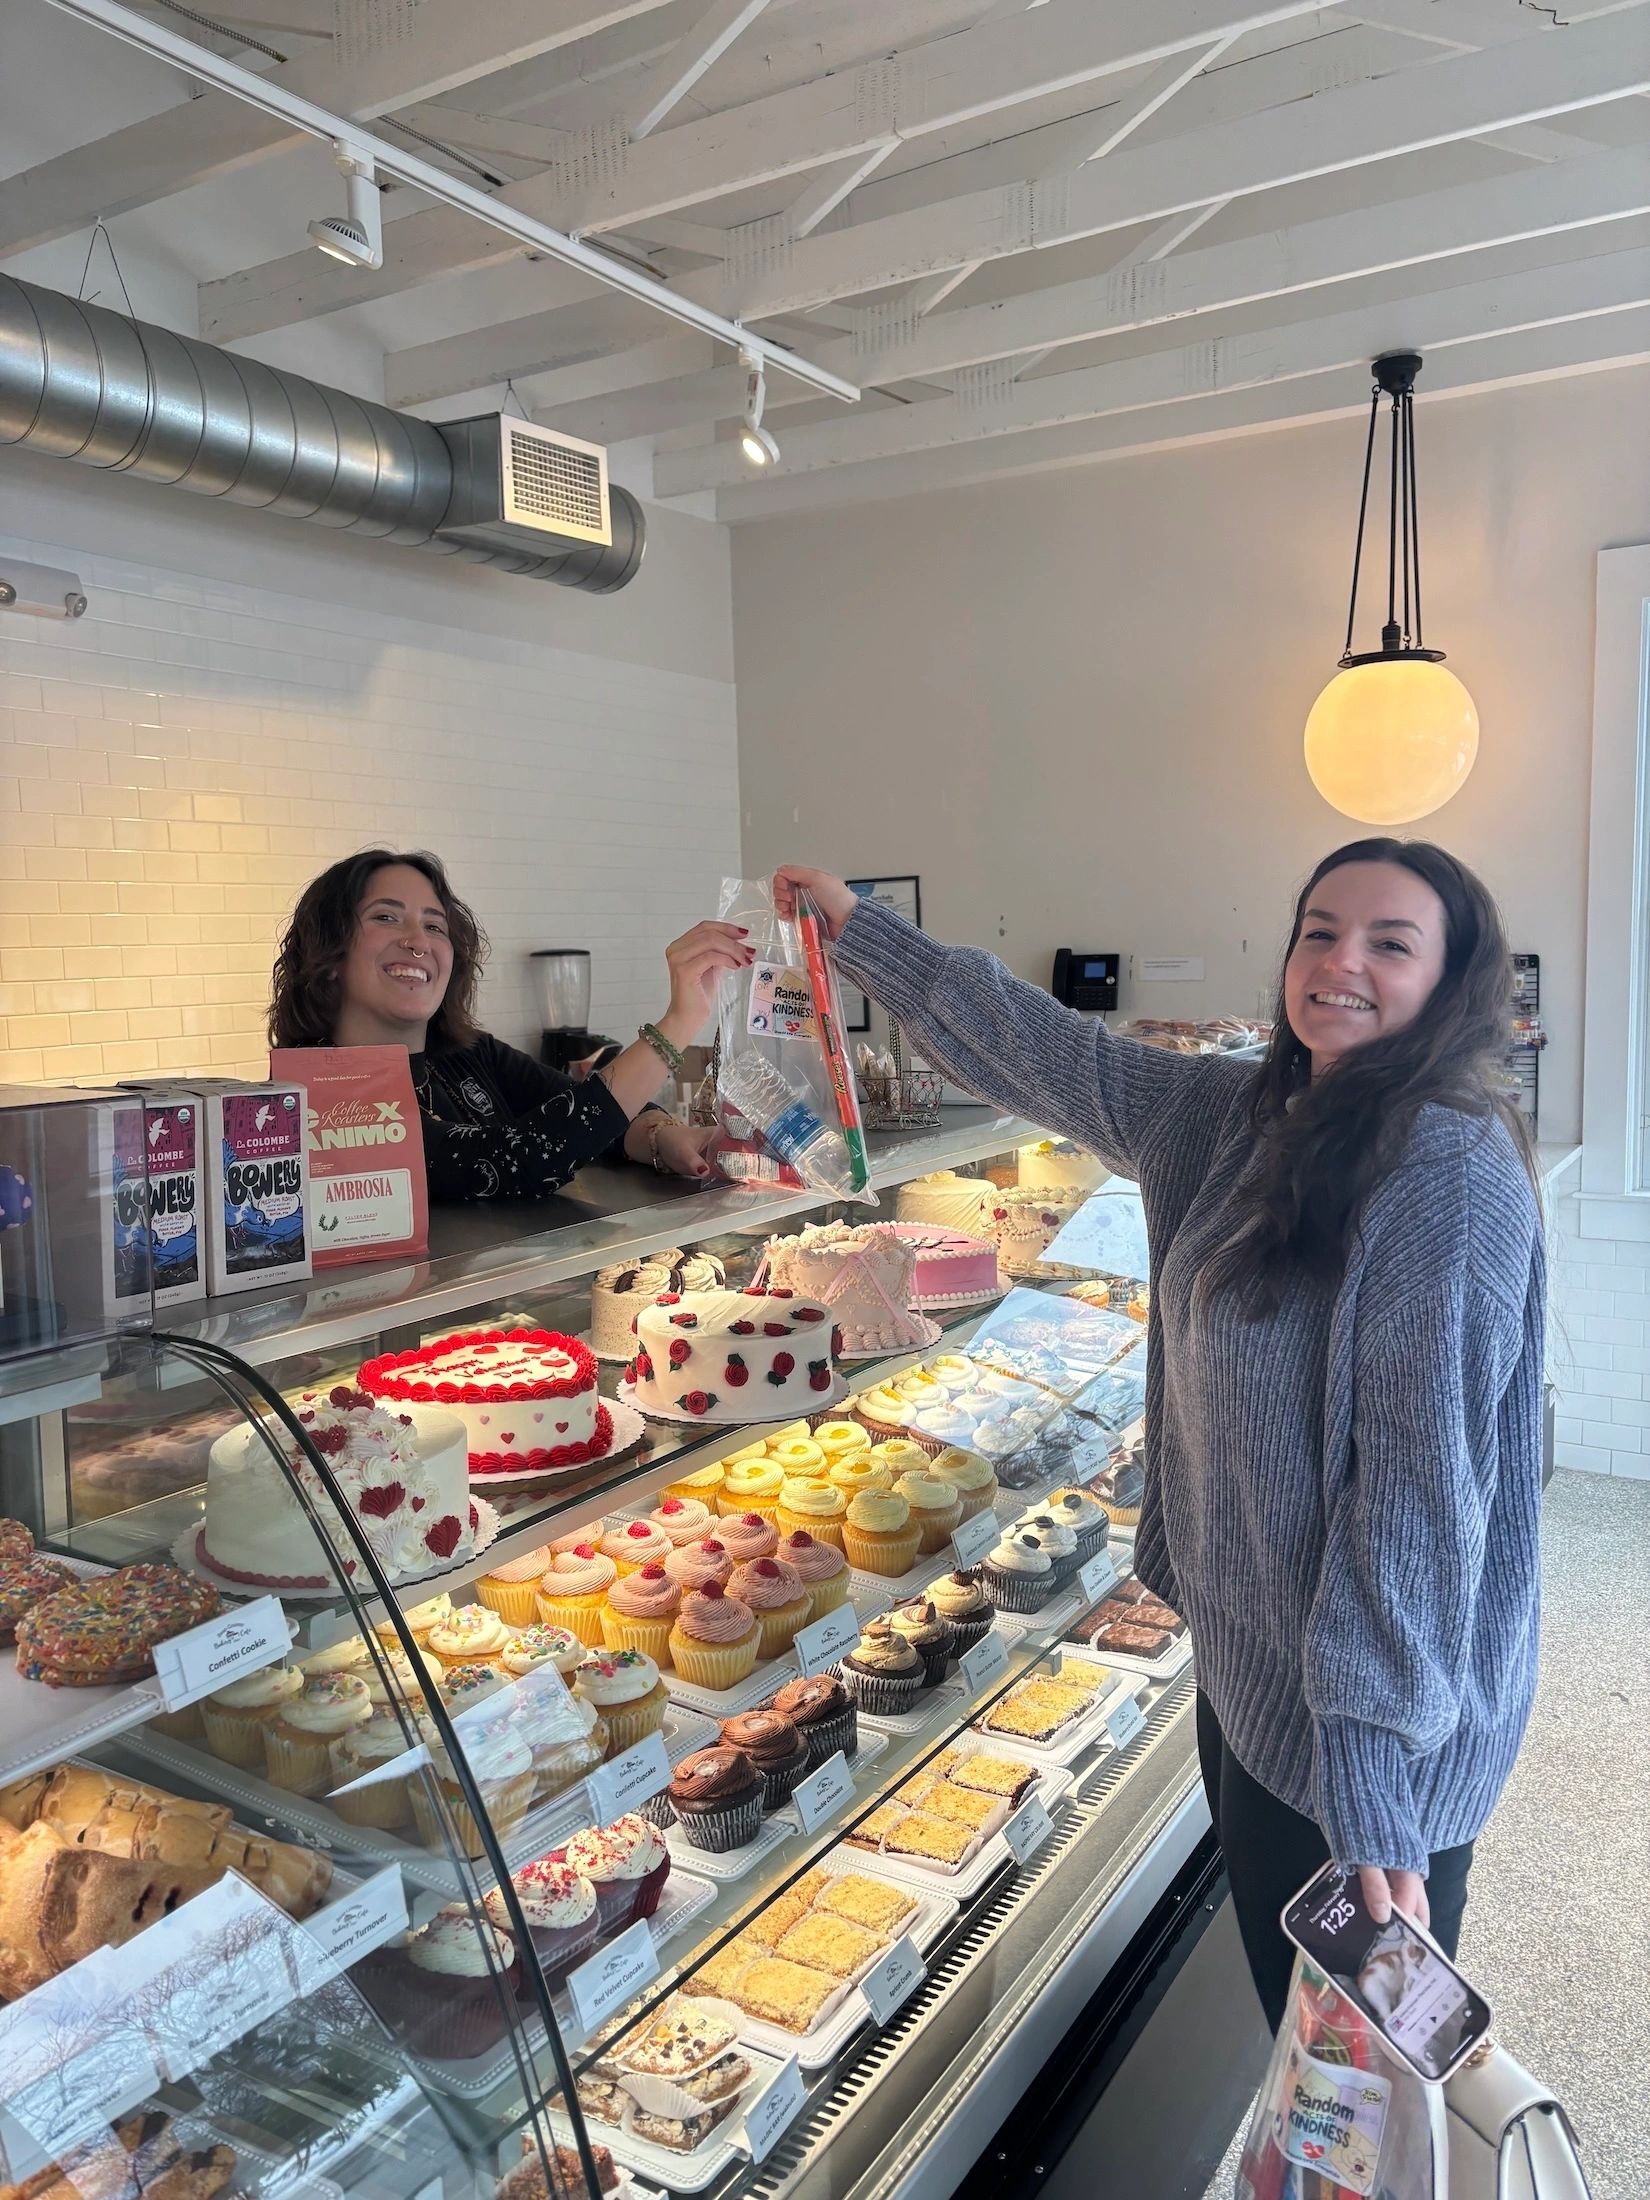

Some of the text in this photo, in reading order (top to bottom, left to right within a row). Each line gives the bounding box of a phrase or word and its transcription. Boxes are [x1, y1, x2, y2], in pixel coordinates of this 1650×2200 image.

[775, 987, 809, 1002] Rando
[772, 1004, 814, 1018] KINDNESS
[322, 1110, 376, 1127] Roasters
[332, 1100, 368, 1116] Coffee
[373, 1101, 404, 1121] X
[236, 1136, 289, 1148] La COLOMBE
[127, 1156, 137, 1165] La
[138, 1162, 175, 1171] CFFEE
[228, 1159, 301, 1205] BOWERY
[326, 1177, 392, 1203] AMBROSIA
[118, 1176, 195, 1225] BOWERY
[493, 1368, 533, 1378] Day
[209, 1638, 267, 1672] Confetti Cookie
[808, 1656, 820, 1666] White
[820, 1644, 839, 1658] Chocolate
[839, 1633, 858, 1647] Raspberry
[616, 1766, 657, 1798] Confetti Cupcake
[814, 1801, 828, 1814] Double
[827, 1786, 844, 1803] Chocolate
[355, 1912, 387, 1939] Turnover
[1320, 1898, 1355, 1935] 1:25
[594, 1994, 605, 2008] Red
[605, 1980, 622, 1997] Velvet
[623, 1961, 644, 1982] Cupcake
[889, 1982, 902, 1997] Apricot
[901, 1970, 912, 1984] Crumb
[232, 1991, 270, 2020] Turnover
[1294, 2084, 1355, 2123] Random
[1303, 2110, 1323, 2120] ACTS
[760, 2127, 773, 2146] MAGIC
[1289, 2108, 1351, 2148] KINDNESS
